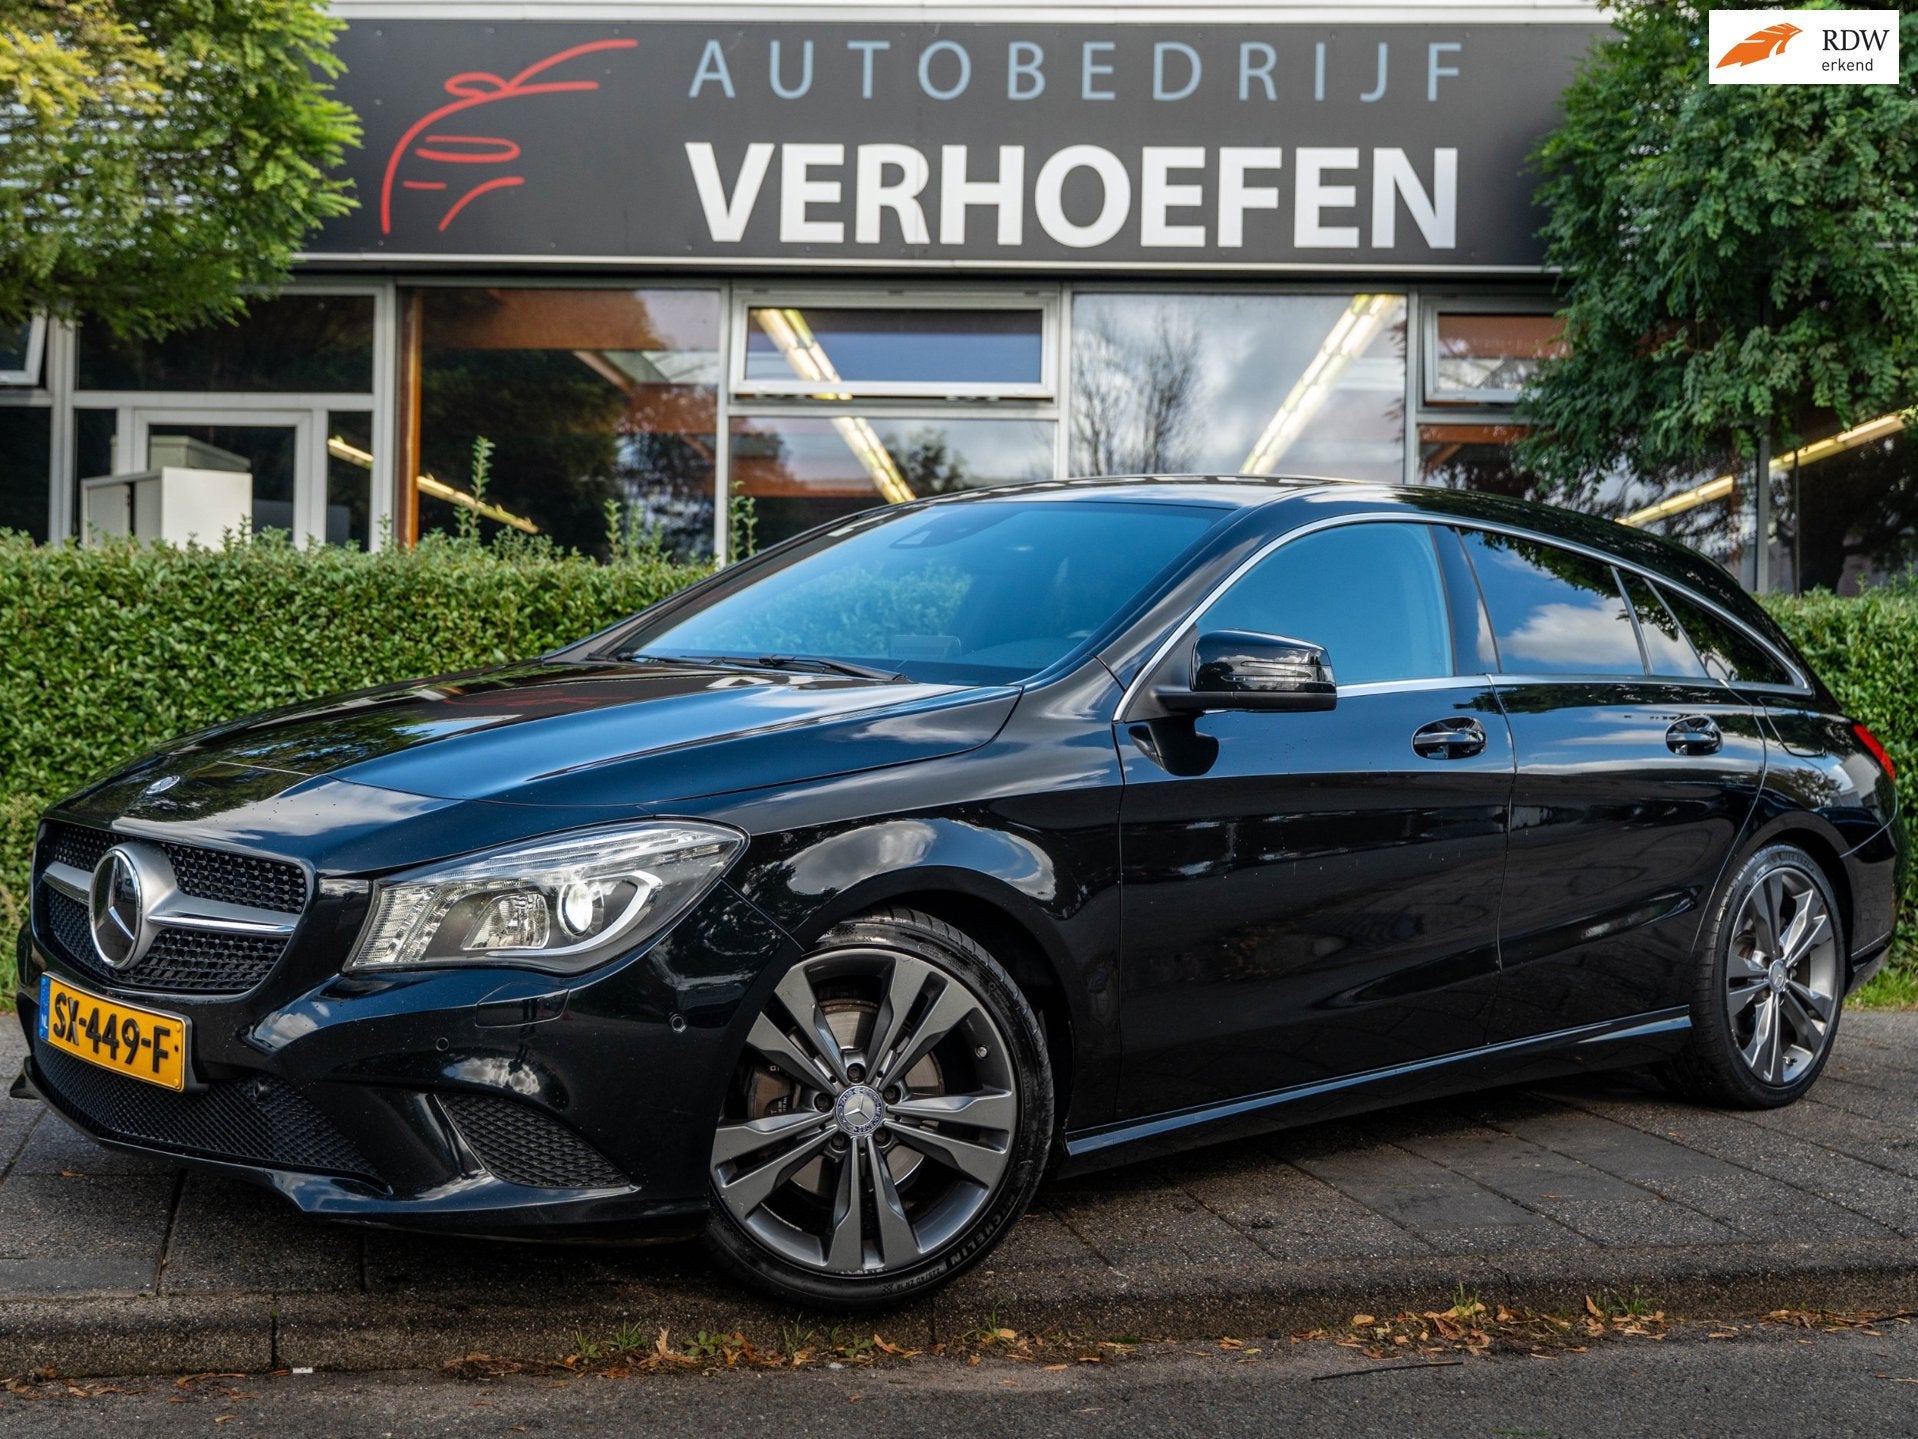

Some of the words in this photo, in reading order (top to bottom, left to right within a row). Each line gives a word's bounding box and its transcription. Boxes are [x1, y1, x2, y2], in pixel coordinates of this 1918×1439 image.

[688, 39, 1463, 103] AUTOBEDRIJF
[685, 141, 1458, 250] VERHOEFEN
[53, 992, 170, 1074] SX-449-F
